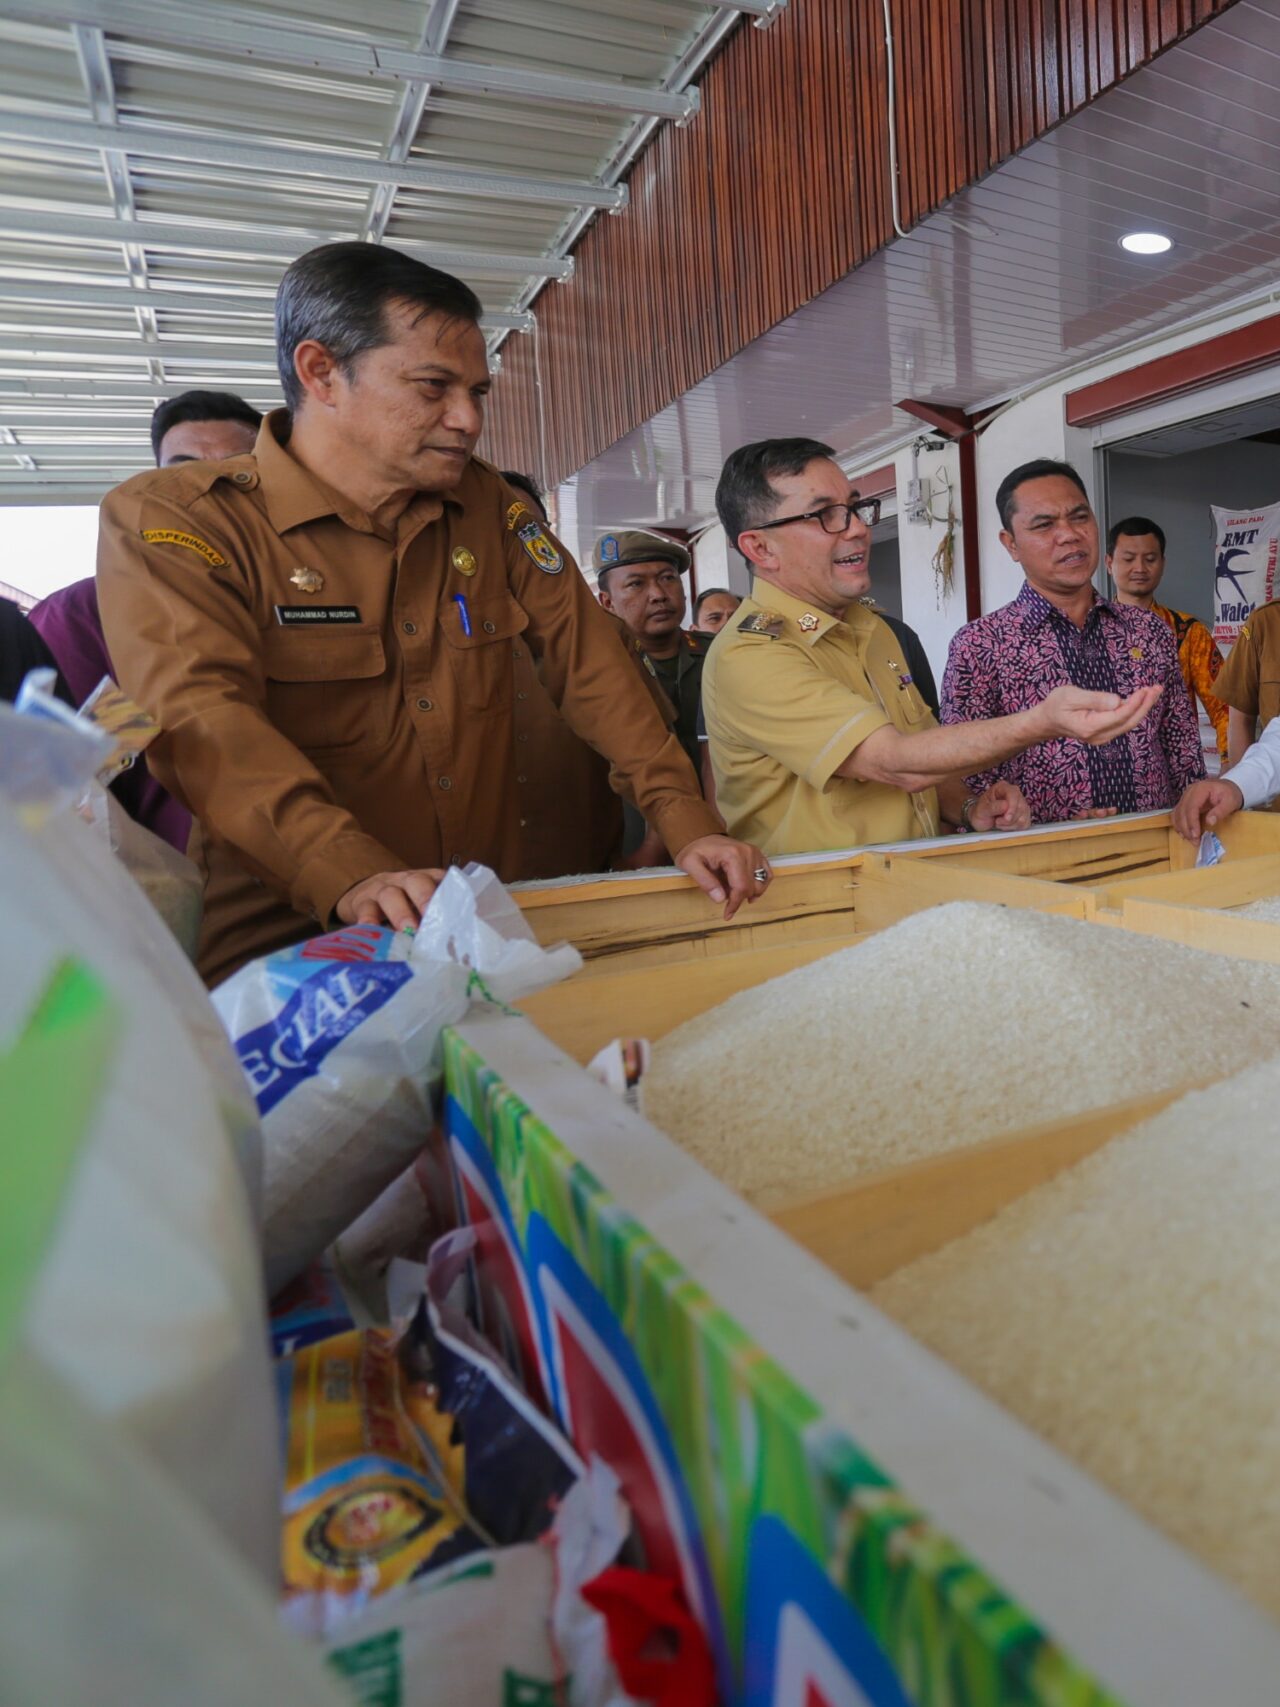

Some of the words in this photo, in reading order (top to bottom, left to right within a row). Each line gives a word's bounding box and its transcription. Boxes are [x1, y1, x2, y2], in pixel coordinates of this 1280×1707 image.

[1269, 538, 1279, 555] AYU
[1265, 558, 1278, 583] PUTRI
[1265, 583, 1274, 602] RAS
[240, 966, 377, 1093] ECIAL
